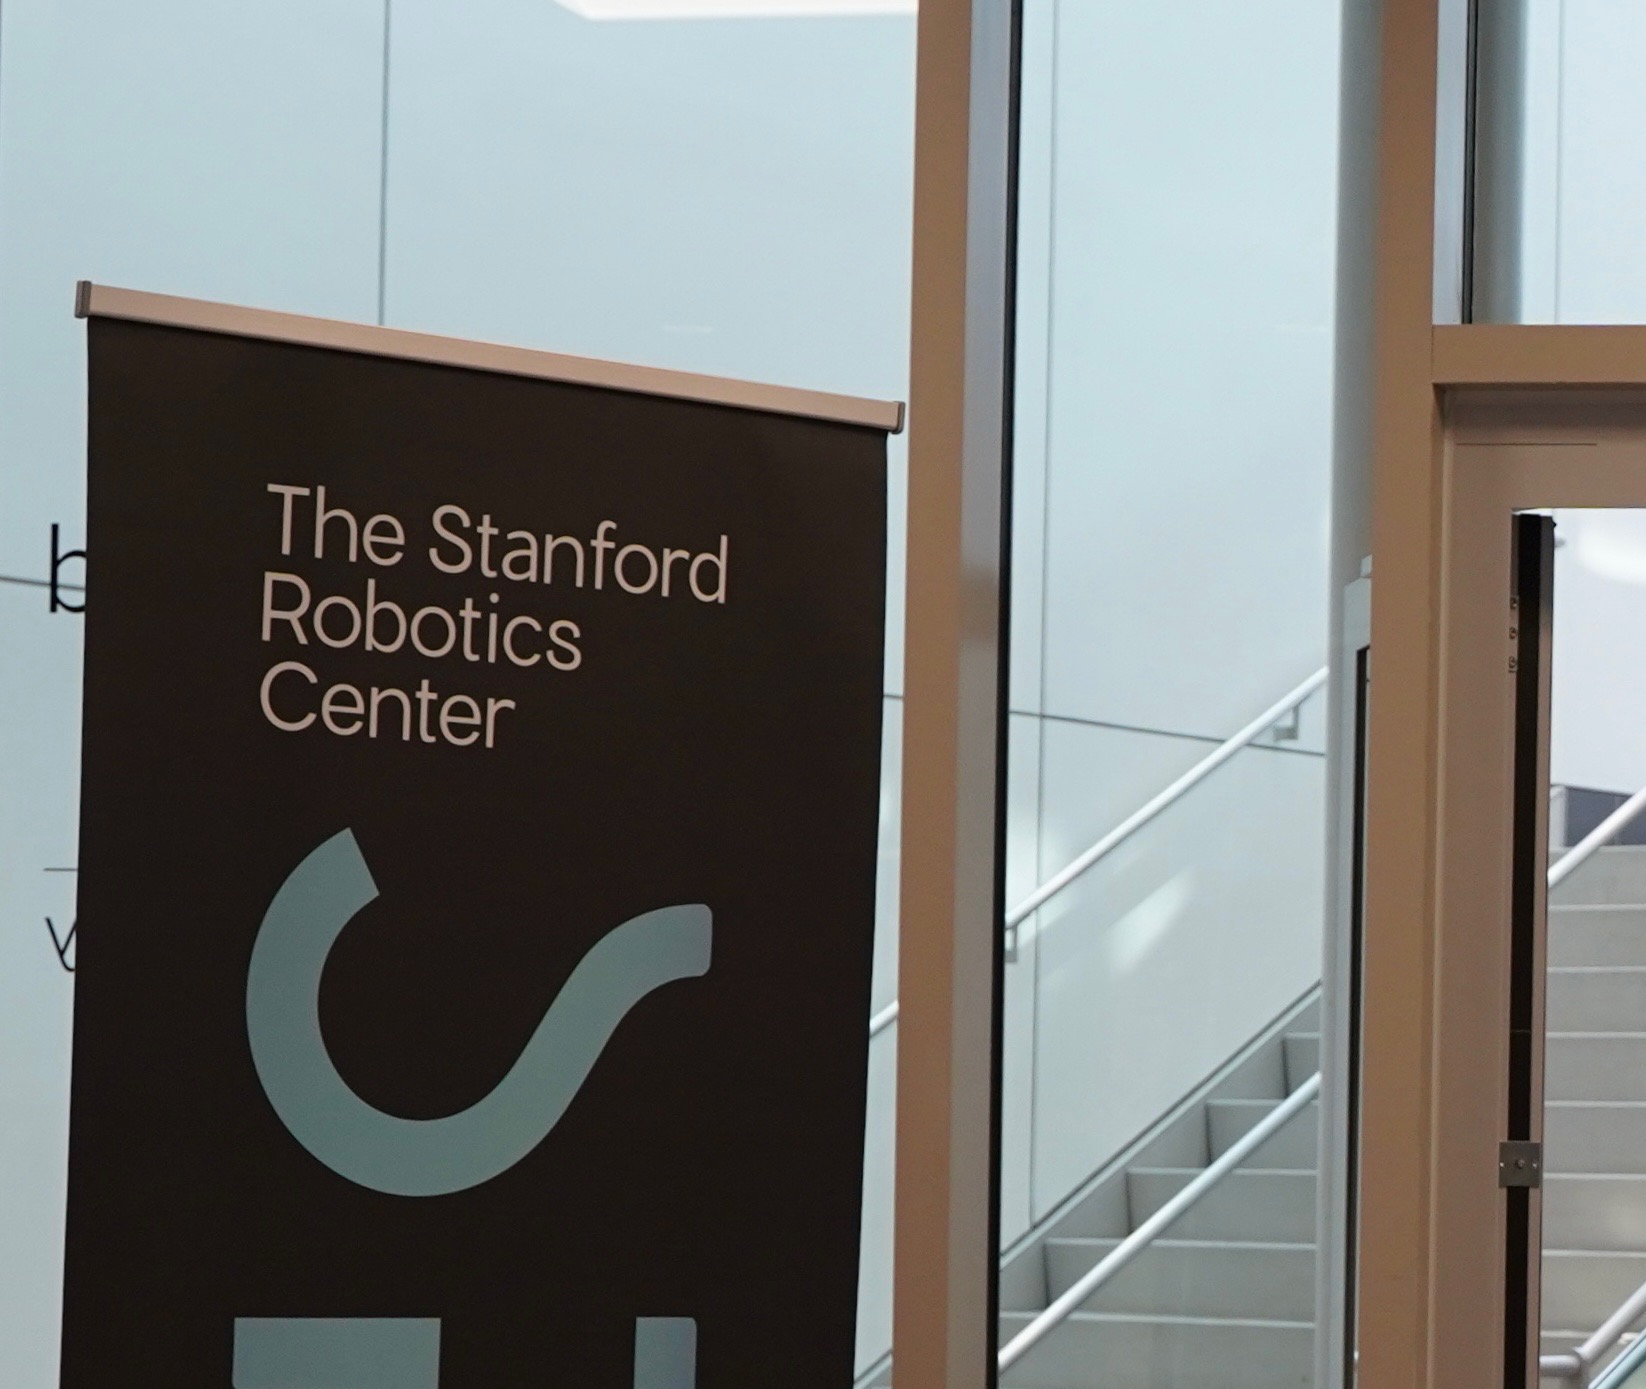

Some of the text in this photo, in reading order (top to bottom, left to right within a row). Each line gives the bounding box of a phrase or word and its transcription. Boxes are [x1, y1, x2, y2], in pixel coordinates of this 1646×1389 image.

[268, 484, 729, 605] The Stanford
[261, 570, 583, 671] Robotics
[259, 660, 516, 749] Center
